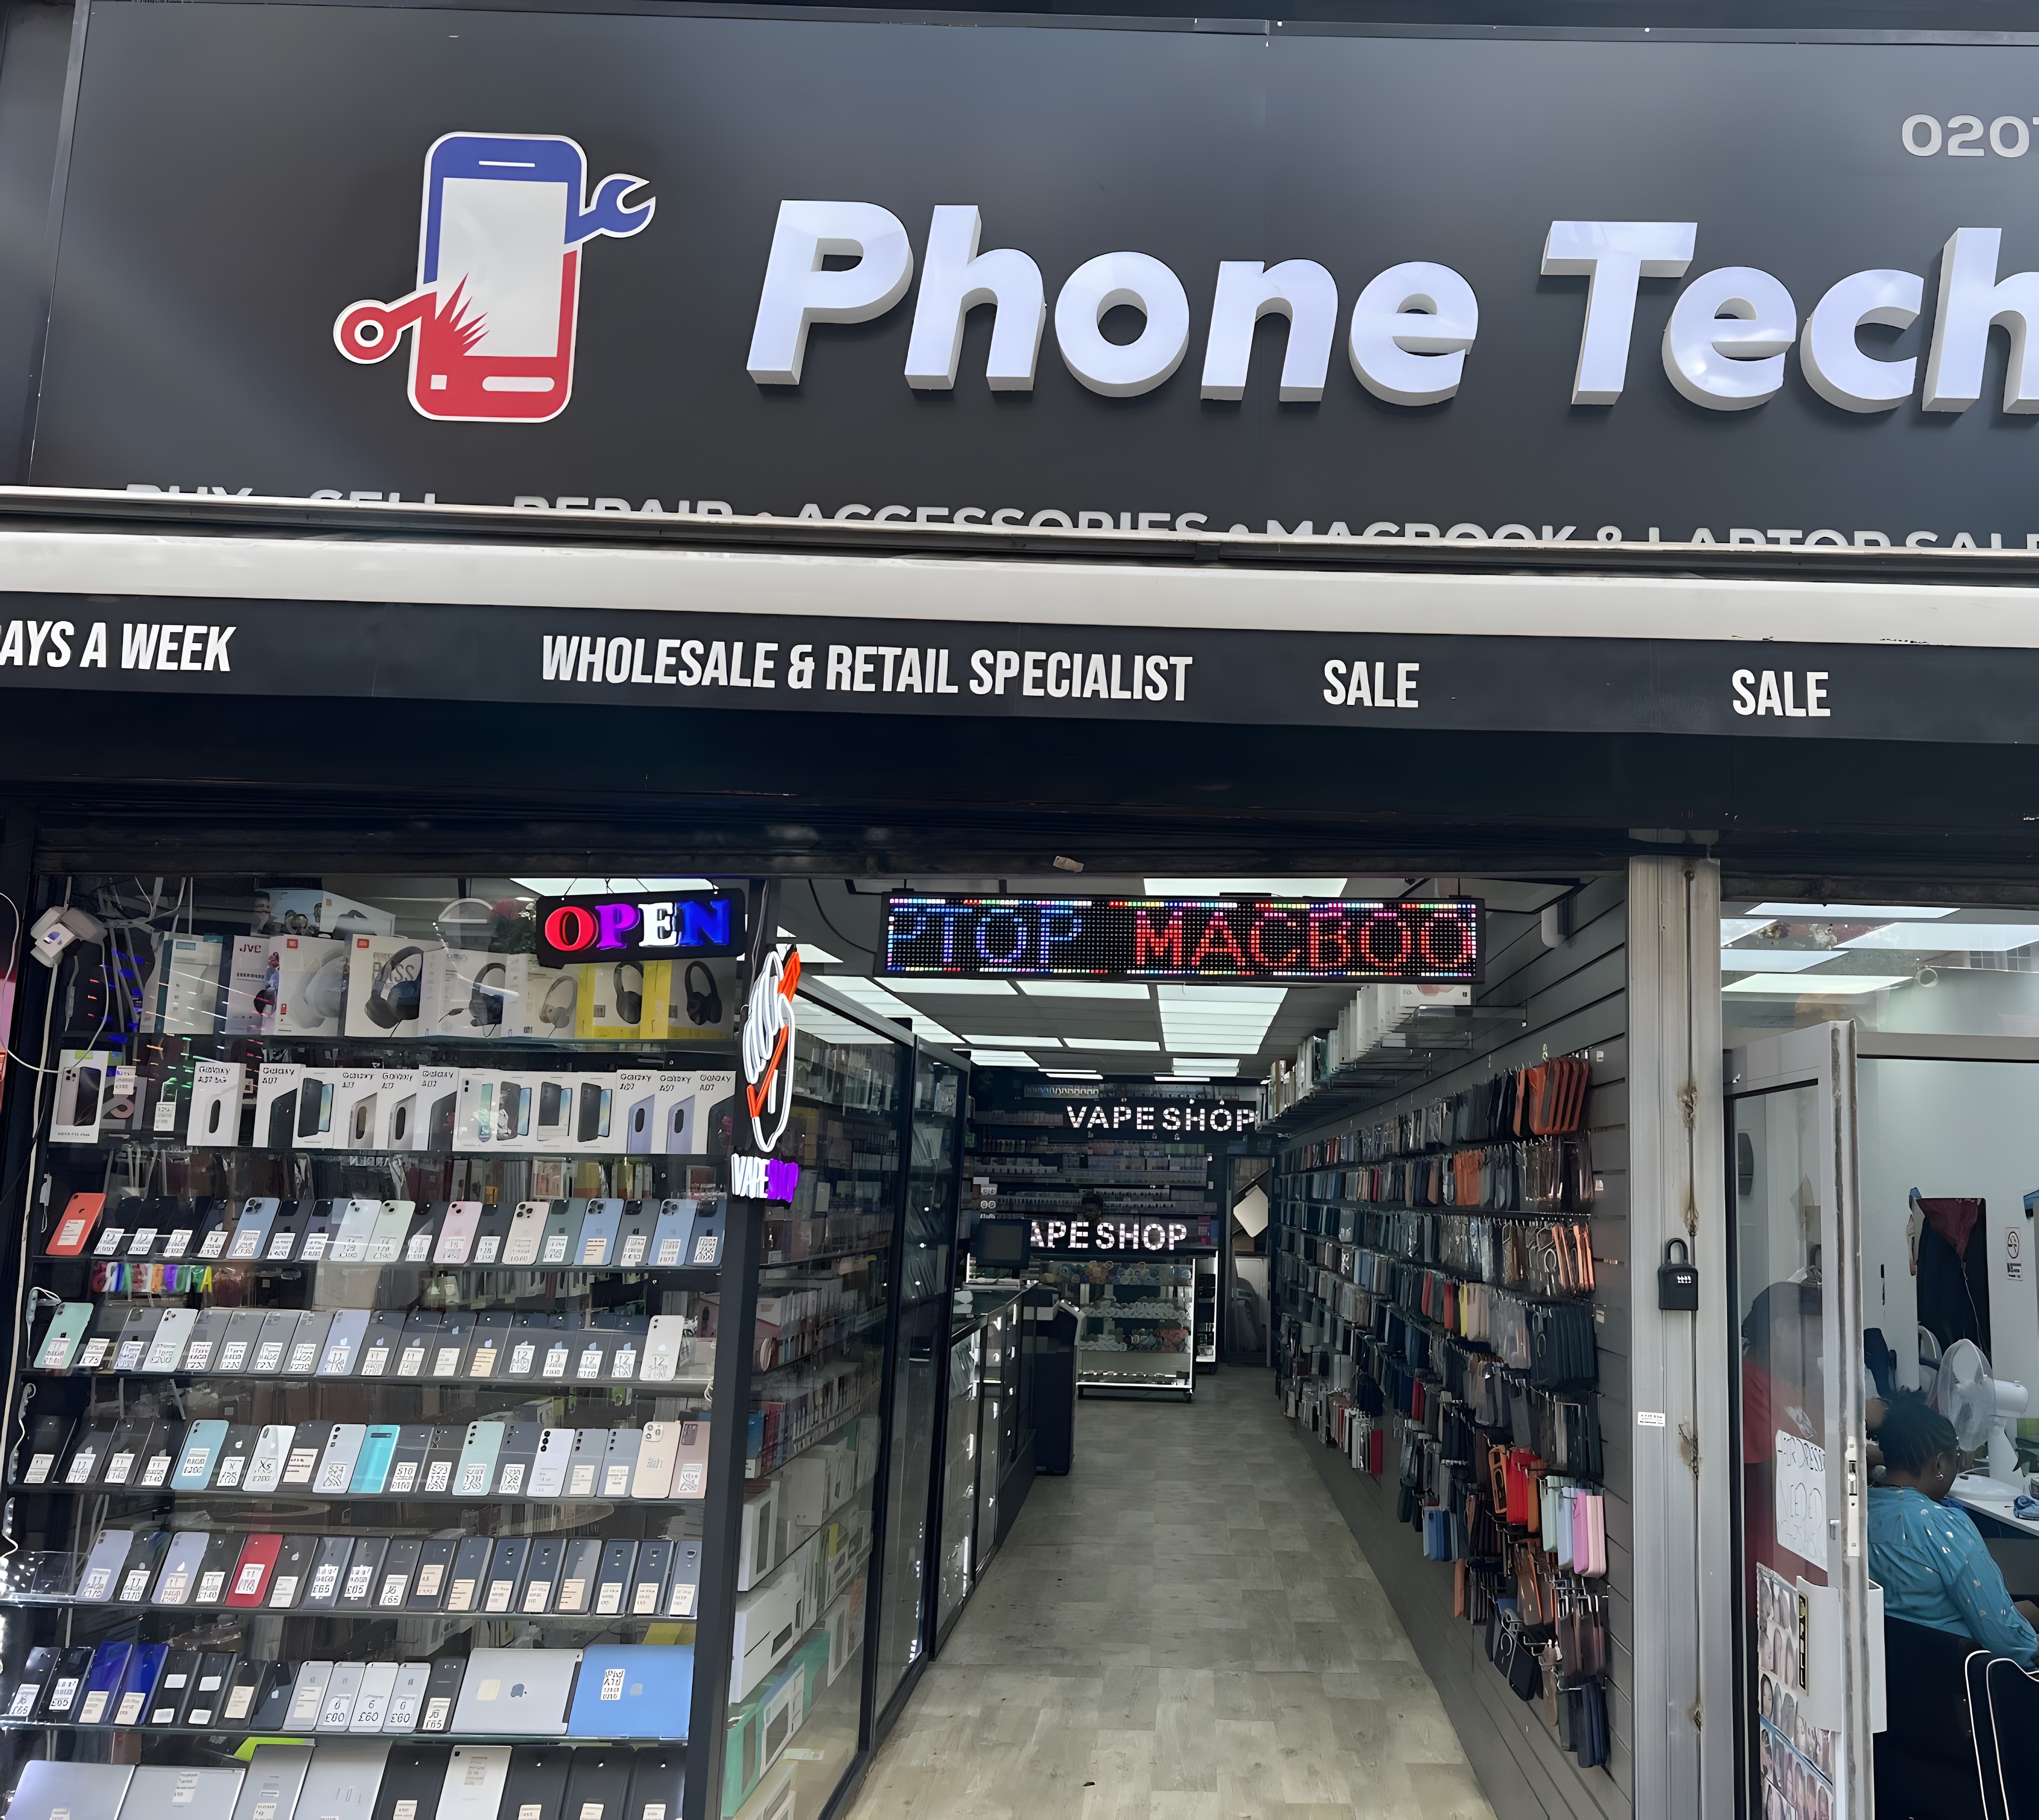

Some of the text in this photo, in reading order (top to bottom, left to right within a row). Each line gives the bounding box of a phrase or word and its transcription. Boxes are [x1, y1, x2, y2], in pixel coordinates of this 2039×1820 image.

[1902, 114, 2039, 157] 020
[747, 200, 2039, 414] Phone Tech
[0, 620, 237, 672] AYS A WEEK
[543, 635, 1193, 701] WHOLESALE & RETAIL SPECIALIST
[1324, 660, 1419, 708] SALE
[1732, 669, 1831, 717] SALE
[545, 899, 730, 951] OPEN
[1066, 1105, 1256, 1132] VAPE SHOP
[1030, 1221, 1188, 1251] APE SHOP
